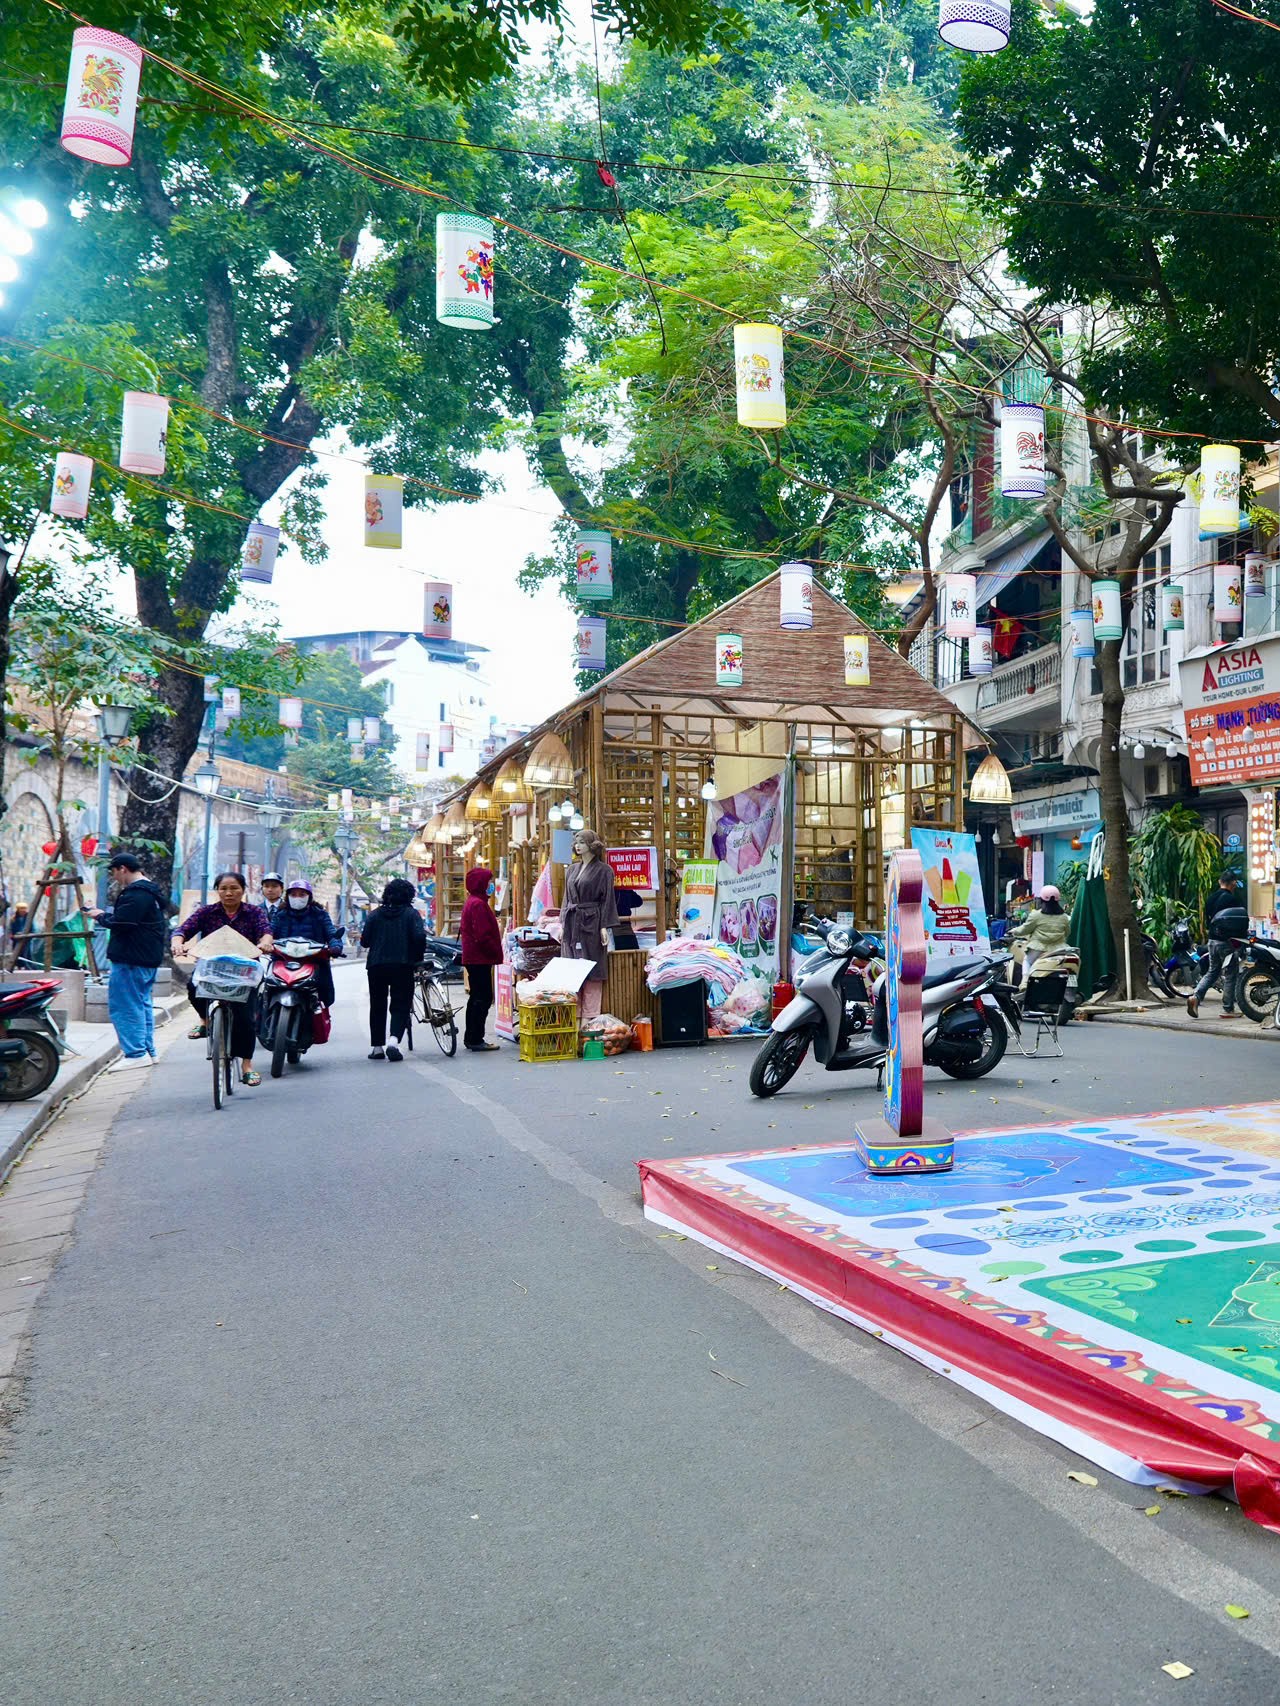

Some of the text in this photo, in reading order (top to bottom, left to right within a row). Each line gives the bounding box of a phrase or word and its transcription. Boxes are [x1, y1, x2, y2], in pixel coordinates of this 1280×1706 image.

[1217, 648, 1263, 674] ASIA
[1220, 669, 1261, 687] LIGHTING
[1202, 693, 1217, 702] YOUR
[1248, 684, 1265, 693] LIGHT
